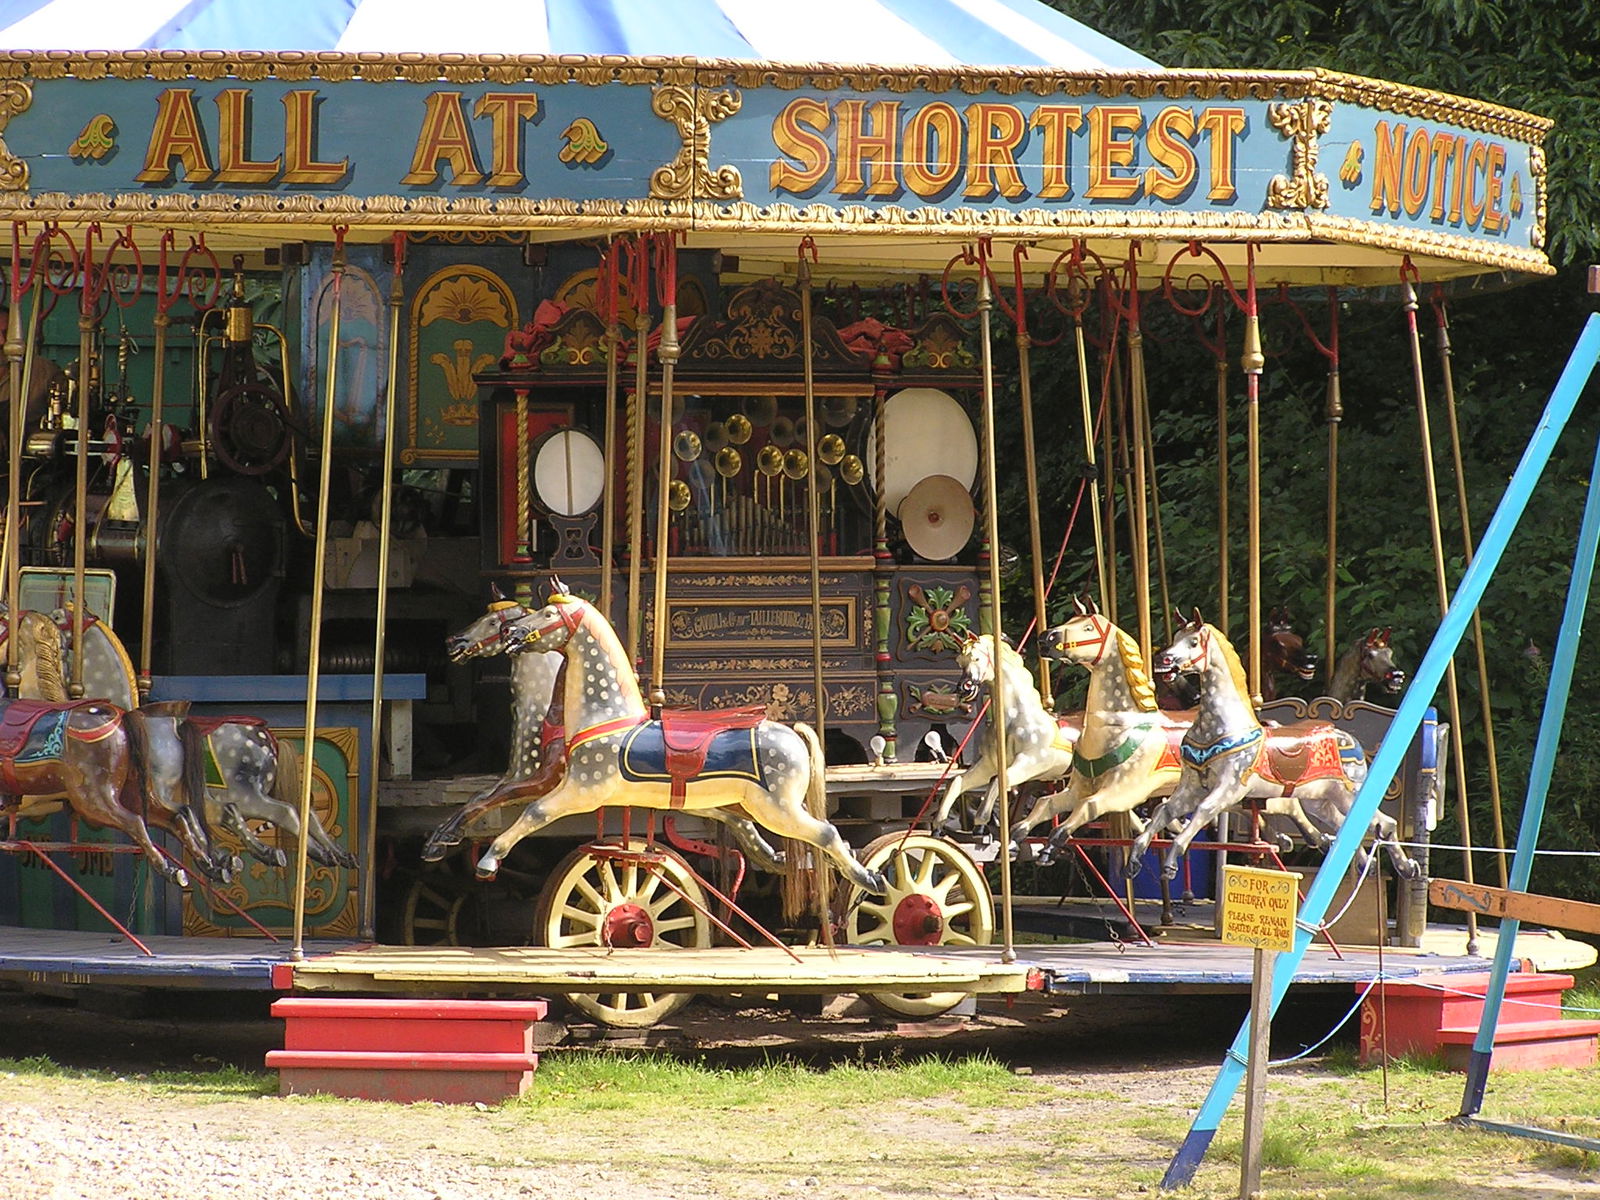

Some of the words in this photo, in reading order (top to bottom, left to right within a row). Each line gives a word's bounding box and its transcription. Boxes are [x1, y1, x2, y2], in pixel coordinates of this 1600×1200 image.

[135, 87, 351, 187] ALL
[400, 91, 541, 188] AT
[768, 98, 1247, 201] SHORTEST
[1249, 878, 1269, 894] FOR
[1228, 892, 1266, 910] CHILDREN
[1268, 898, 1289, 912] ONLY
[1228, 911, 1255, 922] PLEASE
[1259, 914, 1288, 927] REMAIN
[1228, 922, 1251, 933] SEATED
[1251, 924, 1260, 935] AT
[1260, 926, 1272, 936] ALL
[1273, 927, 1290, 939] TIMES
